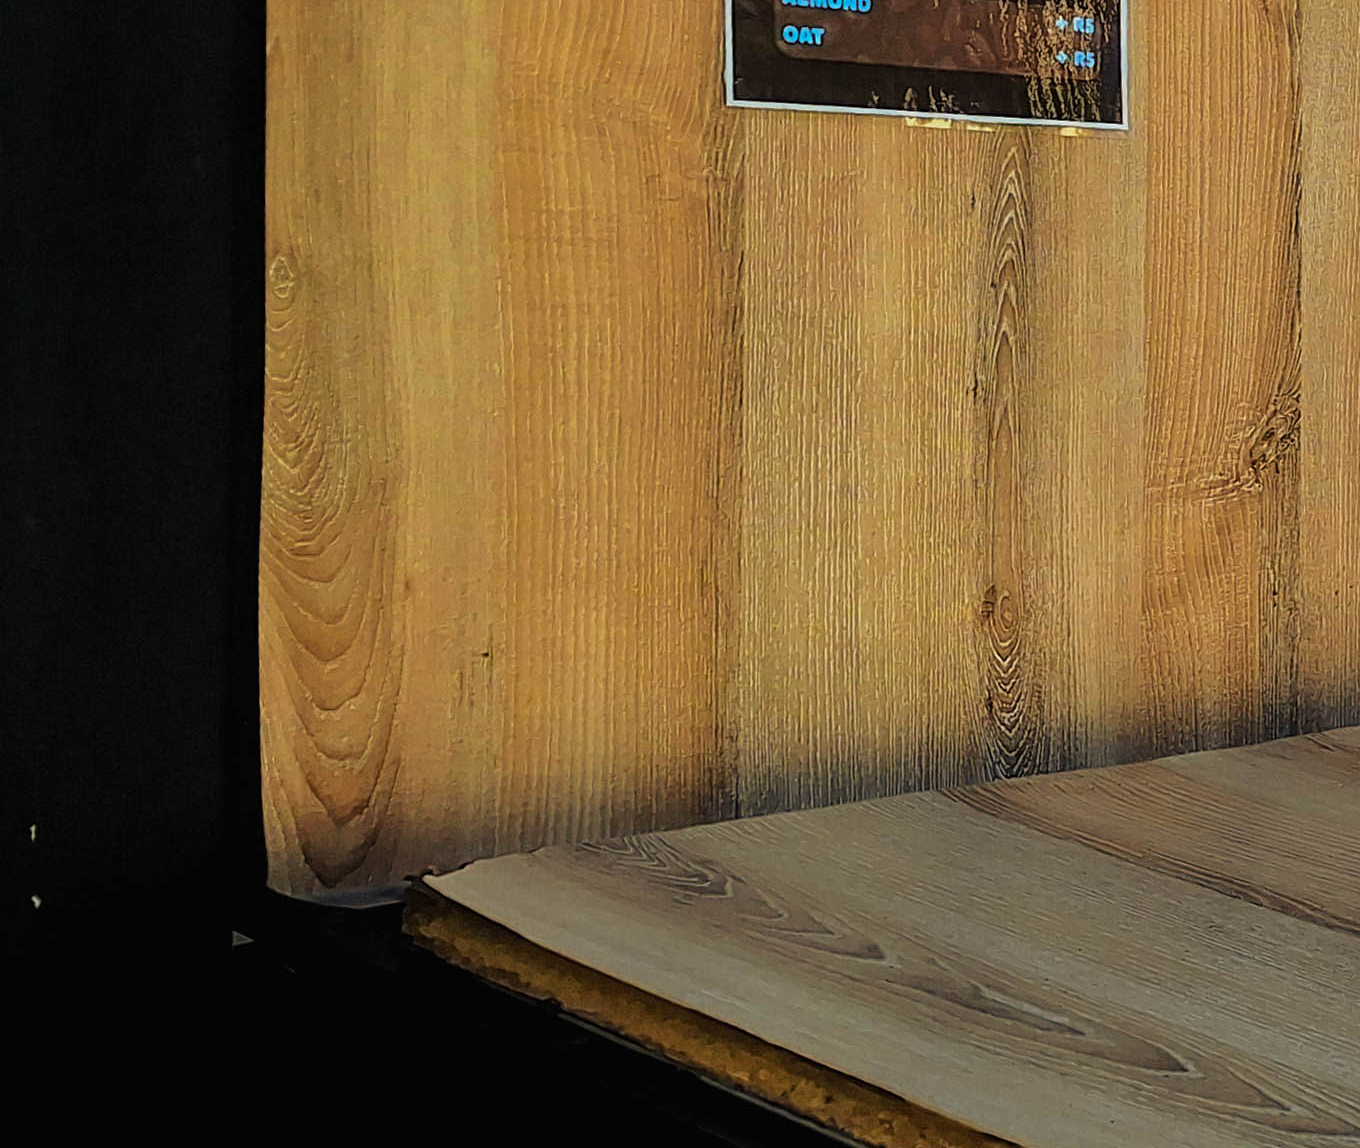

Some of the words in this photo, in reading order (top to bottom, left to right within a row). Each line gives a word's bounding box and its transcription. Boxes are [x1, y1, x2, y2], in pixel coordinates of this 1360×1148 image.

[1073, 15, 1095, 34] R5
[782, 25, 825, 45] OAT
[1073, 51, 1095, 70] R5
